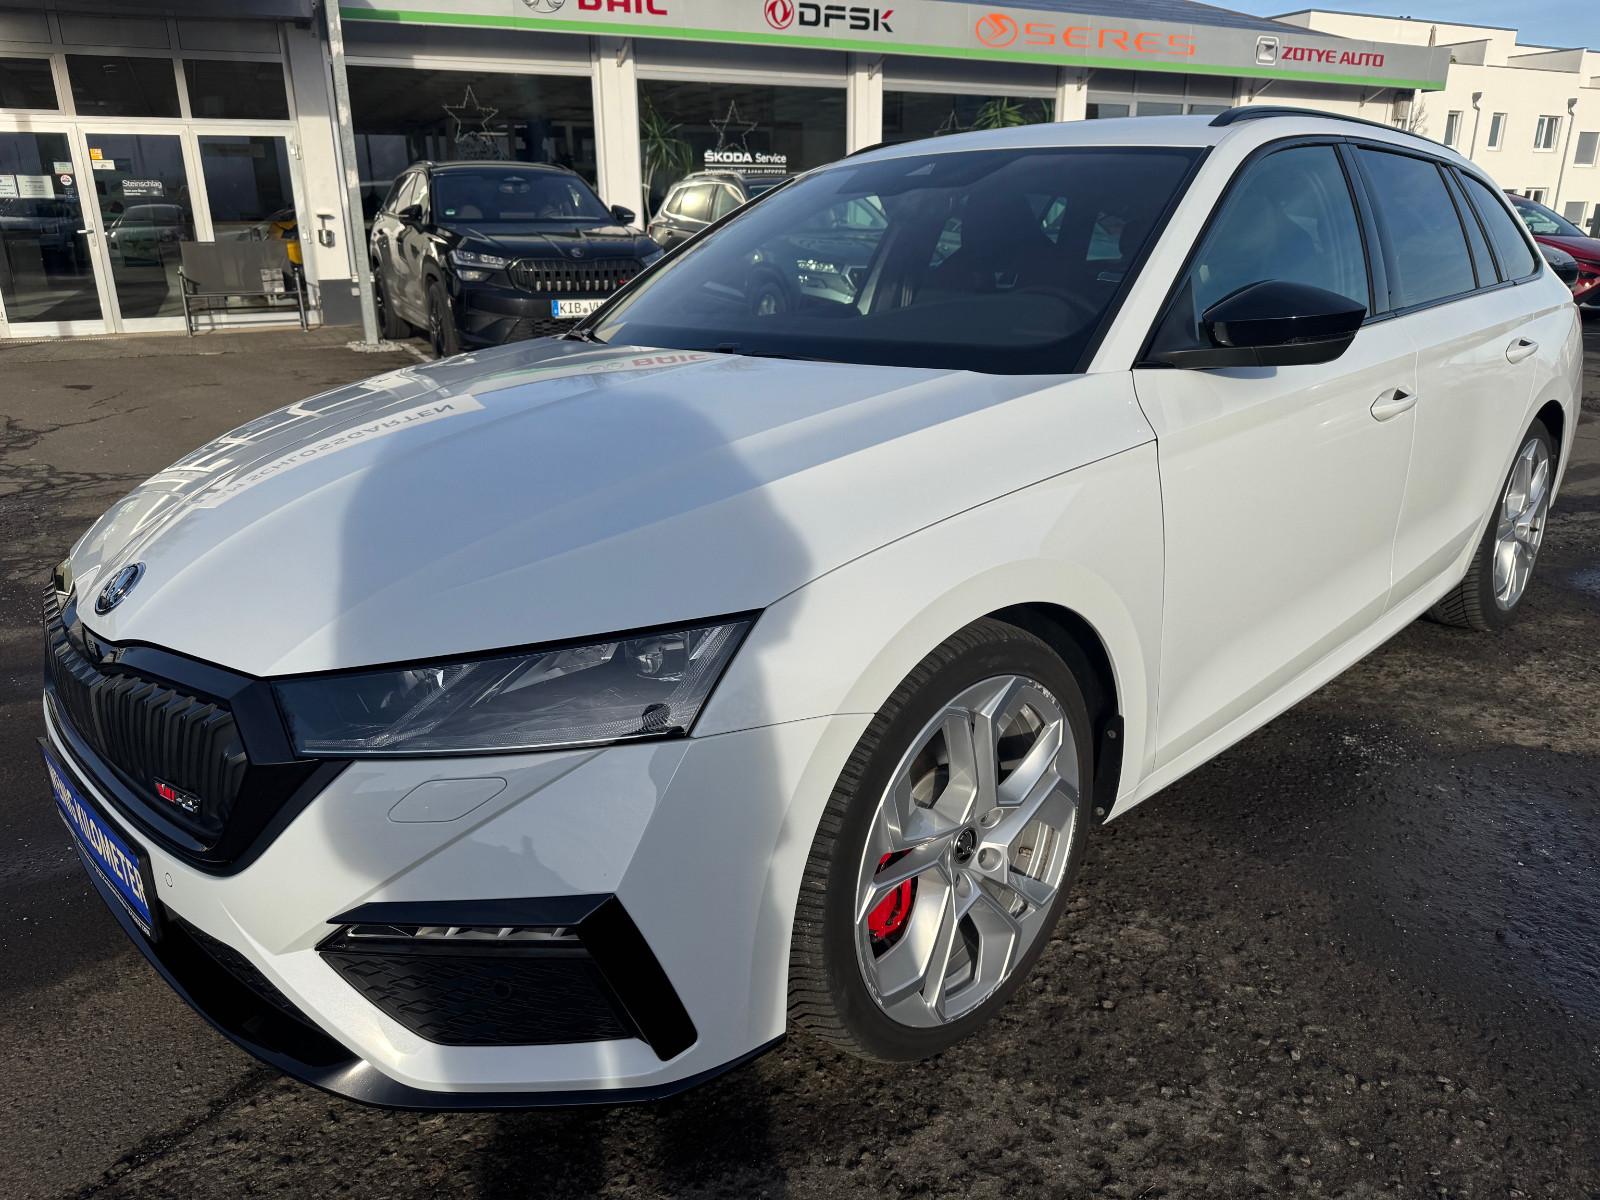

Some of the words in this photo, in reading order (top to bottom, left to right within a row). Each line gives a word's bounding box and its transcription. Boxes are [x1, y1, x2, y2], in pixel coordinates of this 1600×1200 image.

[799, 2, 894, 33] DFSK
[1024, 23, 1196, 56] SERES
[1281, 46, 1337, 64] ZOTYE
[1339, 51, 1385, 67] AUTO
[704, 149, 753, 163] ŠKODA
[755, 152, 787, 163] Service
[122, 179, 163, 188] Steinschlag
[560, 302, 582, 314] KIB
